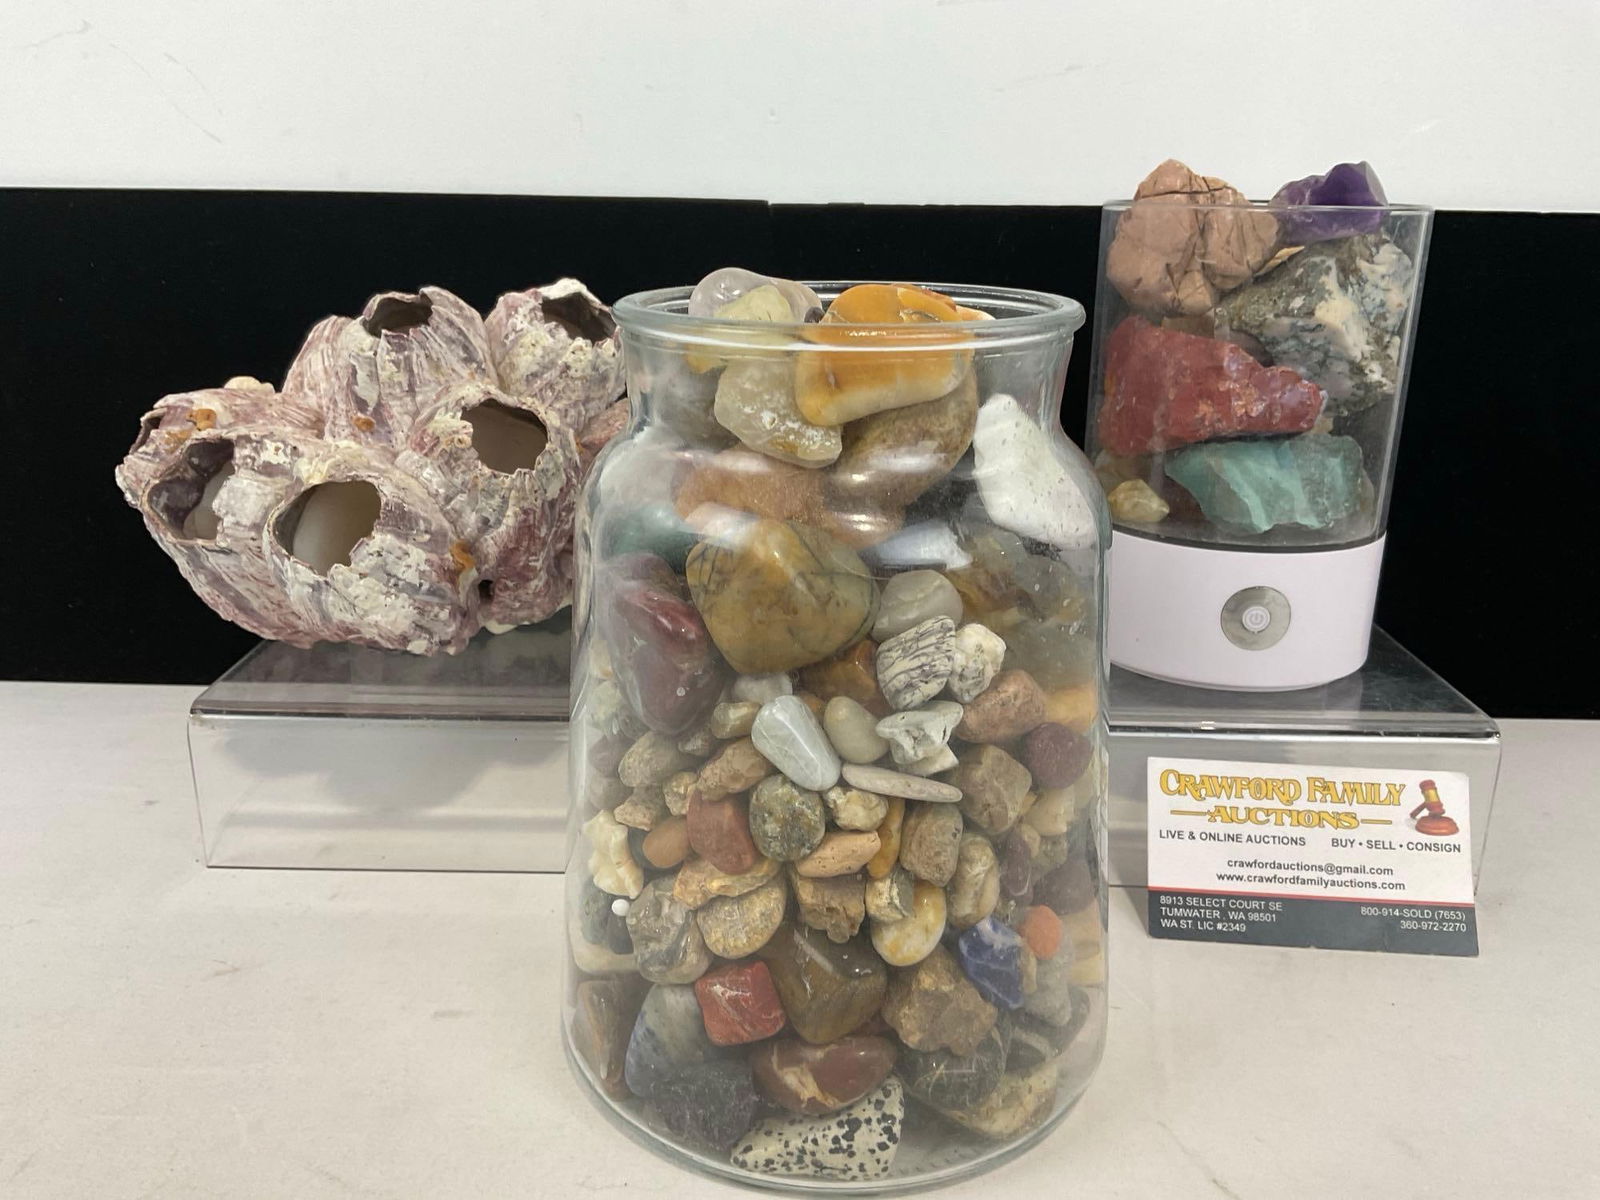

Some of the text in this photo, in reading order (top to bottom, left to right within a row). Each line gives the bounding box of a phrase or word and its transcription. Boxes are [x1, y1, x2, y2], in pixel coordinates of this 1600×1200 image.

[1160, 769, 1406, 806] CRAWFORD FAMILY
[1208, 806, 1360, 830] AUCTIONS
[1159, 829, 1306, 846] LIVE & ONLINE AUCTIONS
[1331, 838, 1461, 853] BUY SELL CONSIGN
[1227, 859, 1394, 876] crawfordauctions@gmail.com
[1216, 873, 1406, 890] www.crawfordfamilyauctions.com
[1160, 895, 1283, 911] 8913 SELECT COURT SE
[1228, 911, 1245, 920] WA
[1247, 912, 1277, 922] 98501
[1360, 906, 1466, 921] 800-914-SOLD (7653)
[1160, 918, 1178, 928] WA
[1197, 921, 1214, 930] LIC
[1216, 922, 1246, 932] #2349
[1400, 920, 1467, 932] 360-972-2270
